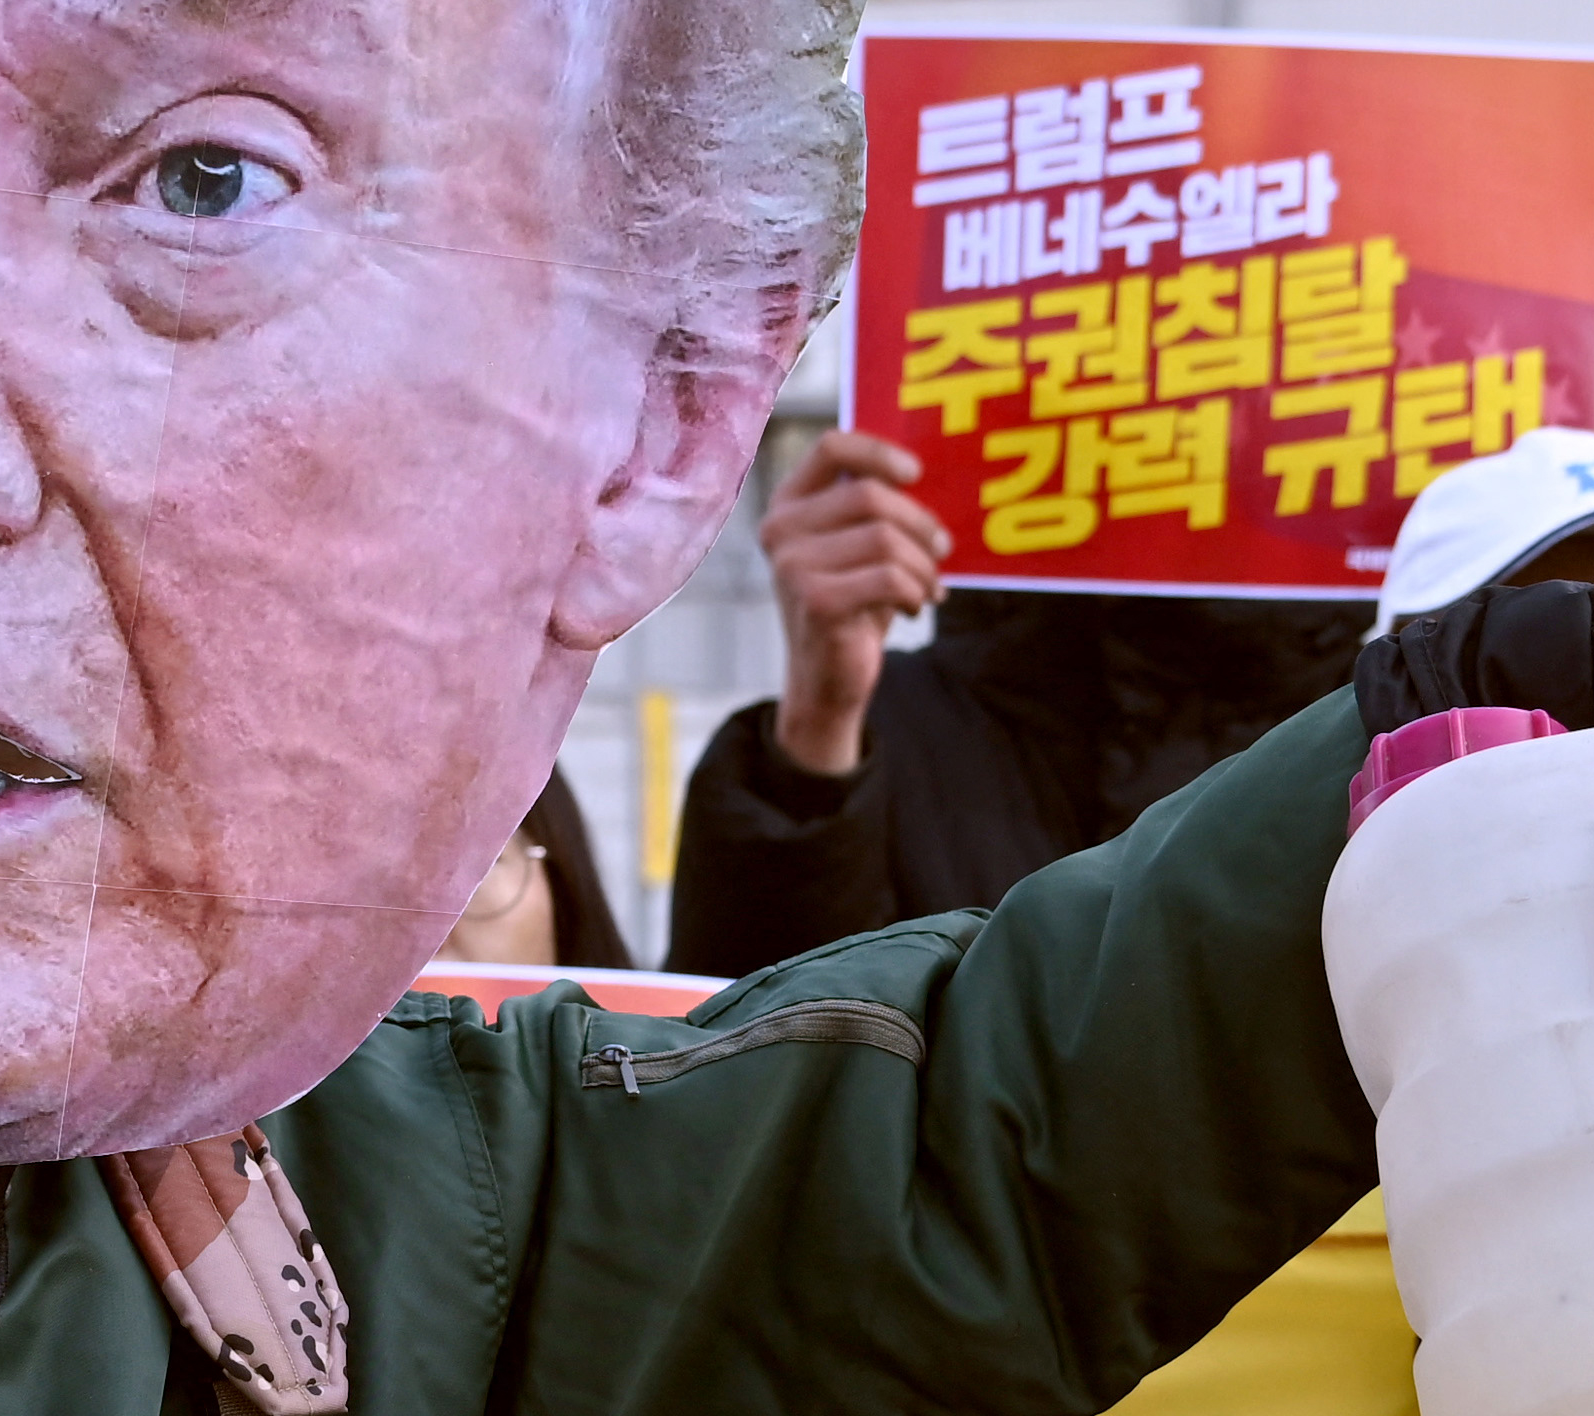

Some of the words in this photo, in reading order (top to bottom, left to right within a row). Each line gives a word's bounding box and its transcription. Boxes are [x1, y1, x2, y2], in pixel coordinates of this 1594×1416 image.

[911, 64, 1204, 208] 트럼프
[942, 152, 1338, 292] 베네수엘라
[898, 237, 1409, 436] 주권침탈
[979, 397, 1231, 555] 강력
